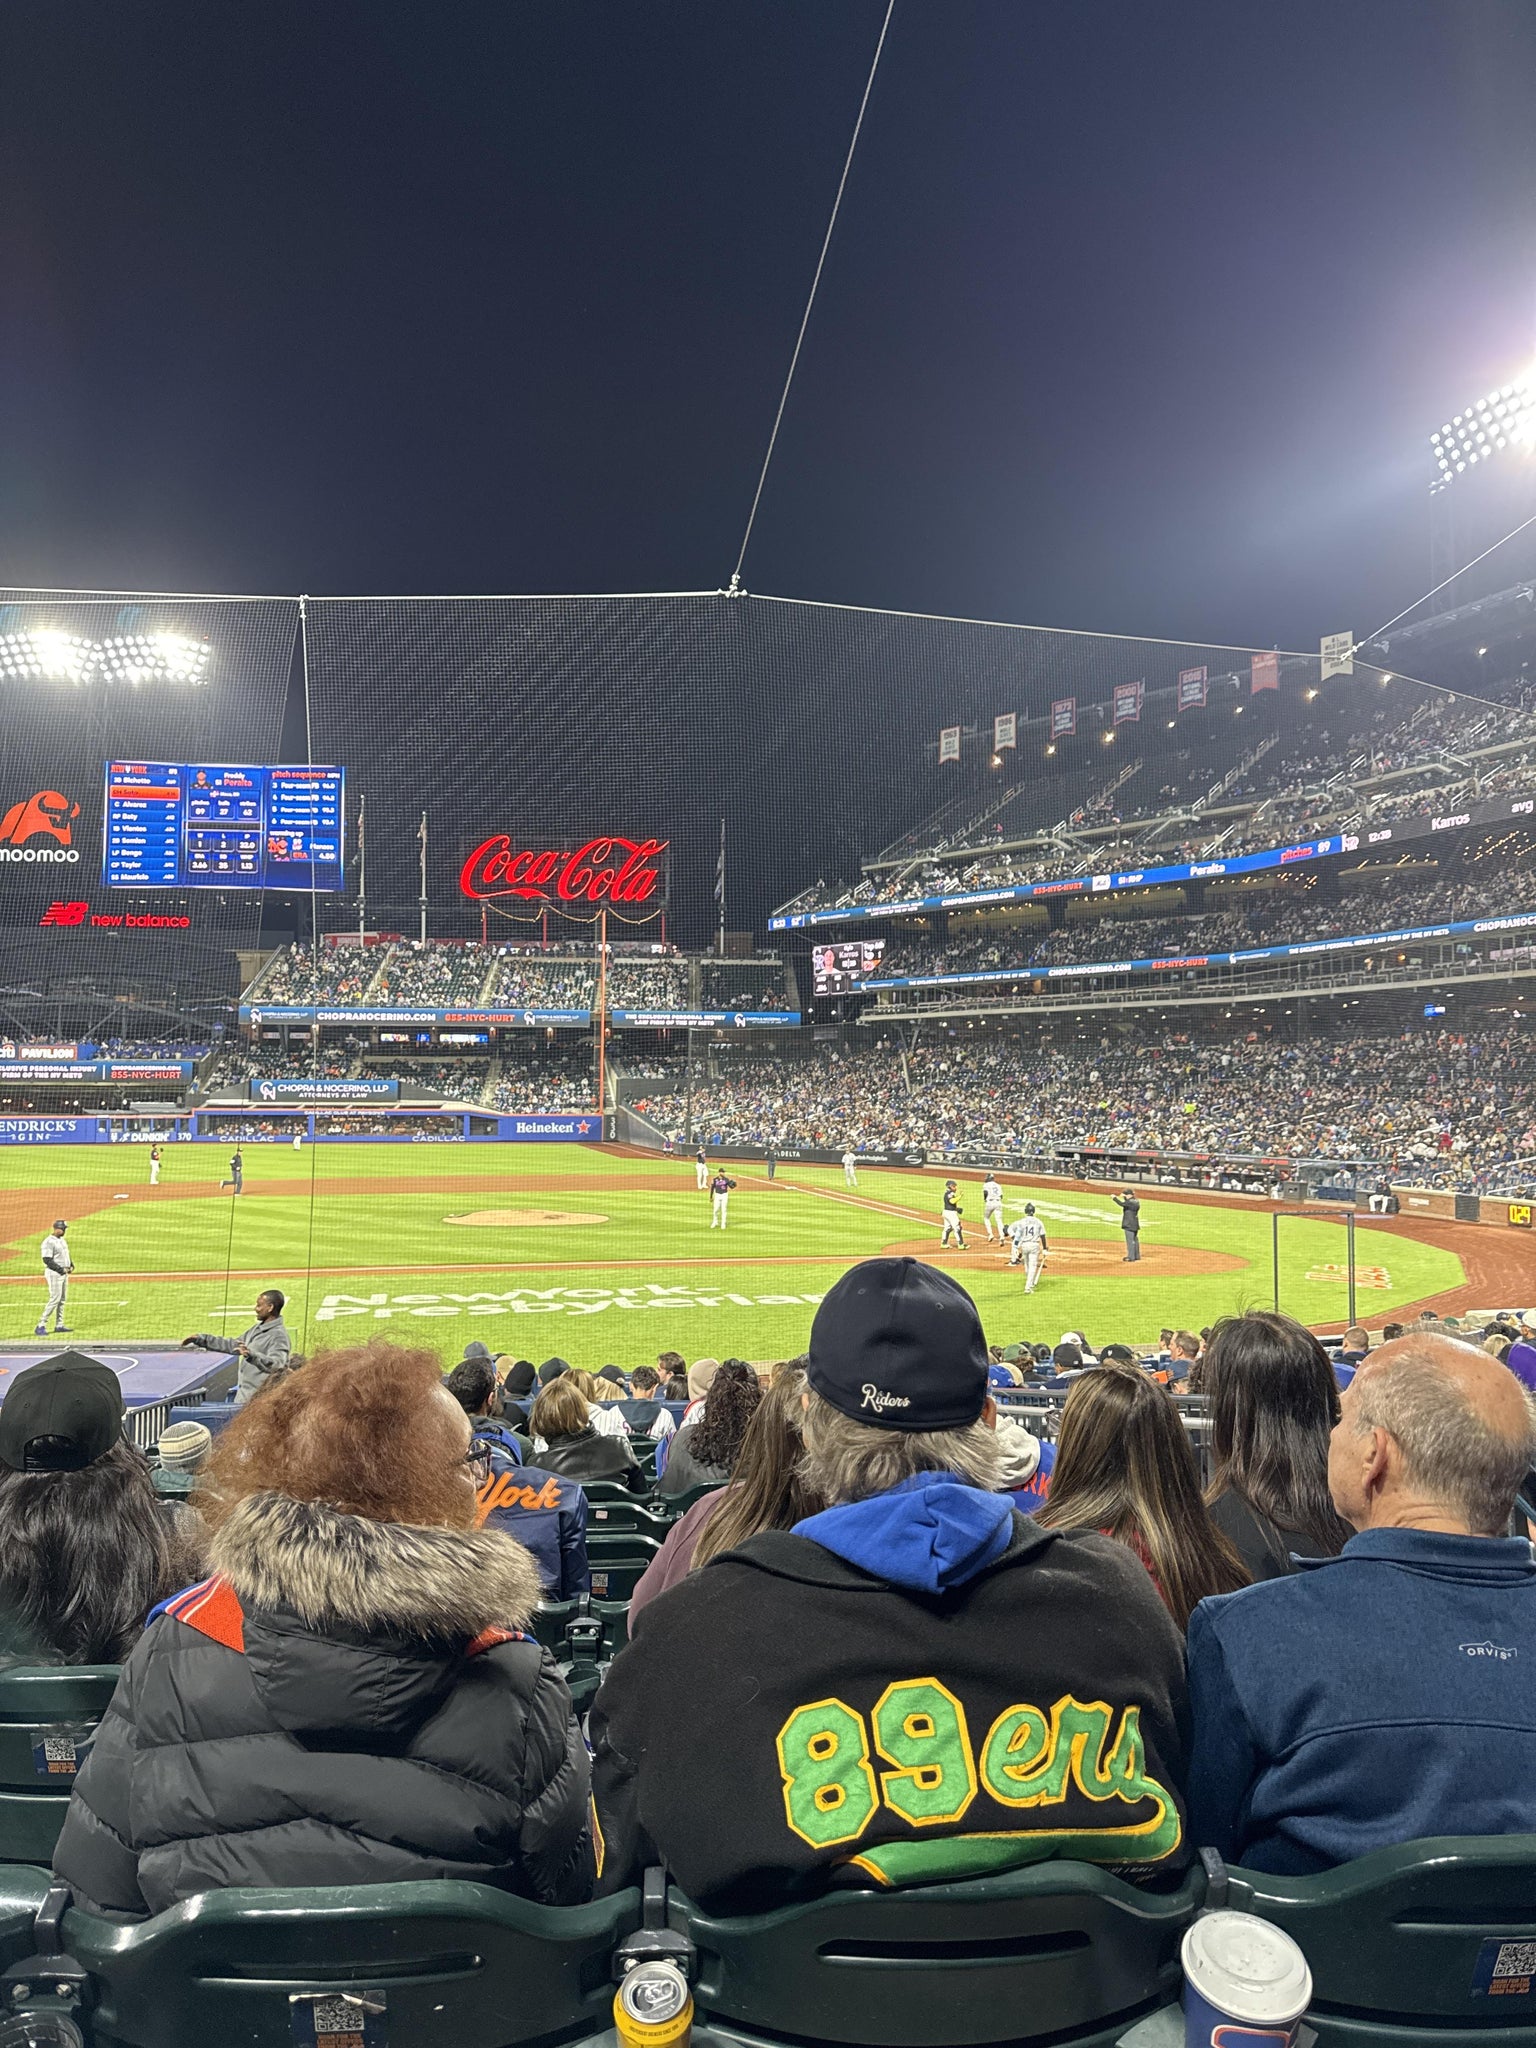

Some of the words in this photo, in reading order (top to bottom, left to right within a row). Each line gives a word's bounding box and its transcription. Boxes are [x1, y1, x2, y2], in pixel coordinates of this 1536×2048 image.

[1511, 800, 1534, 814] avg
[1432, 813, 1471, 831] Karros
[1280, 846, 1313, 864] pitches
[459, 834, 670, 902] Coca-Cola
[1190, 863, 1226, 877] Peralta
[91, 914, 123, 927] new
[126, 914, 190, 928] balance
[317, 1012, 436, 1021] CHOPRANOCERINO.COM
[21, 1048, 75, 1058] PAVILION
[278, 1084, 314, 1092] CHOPRA
[324, 1085, 372, 1093] NOCERINO,
[516, 1122, 574, 1133] Heineken
[178, 1132, 192, 1141] 370
[780, 1150, 800, 1158] DELTA
[1025, 1226, 1034, 1236] 14
[860, 1383, 911, 1413] Riders
[472, 1471, 562, 1530] York
[1467, 1647, 1508, 1660] ORVIS
[776, 1676, 1172, 1852] 89ers
